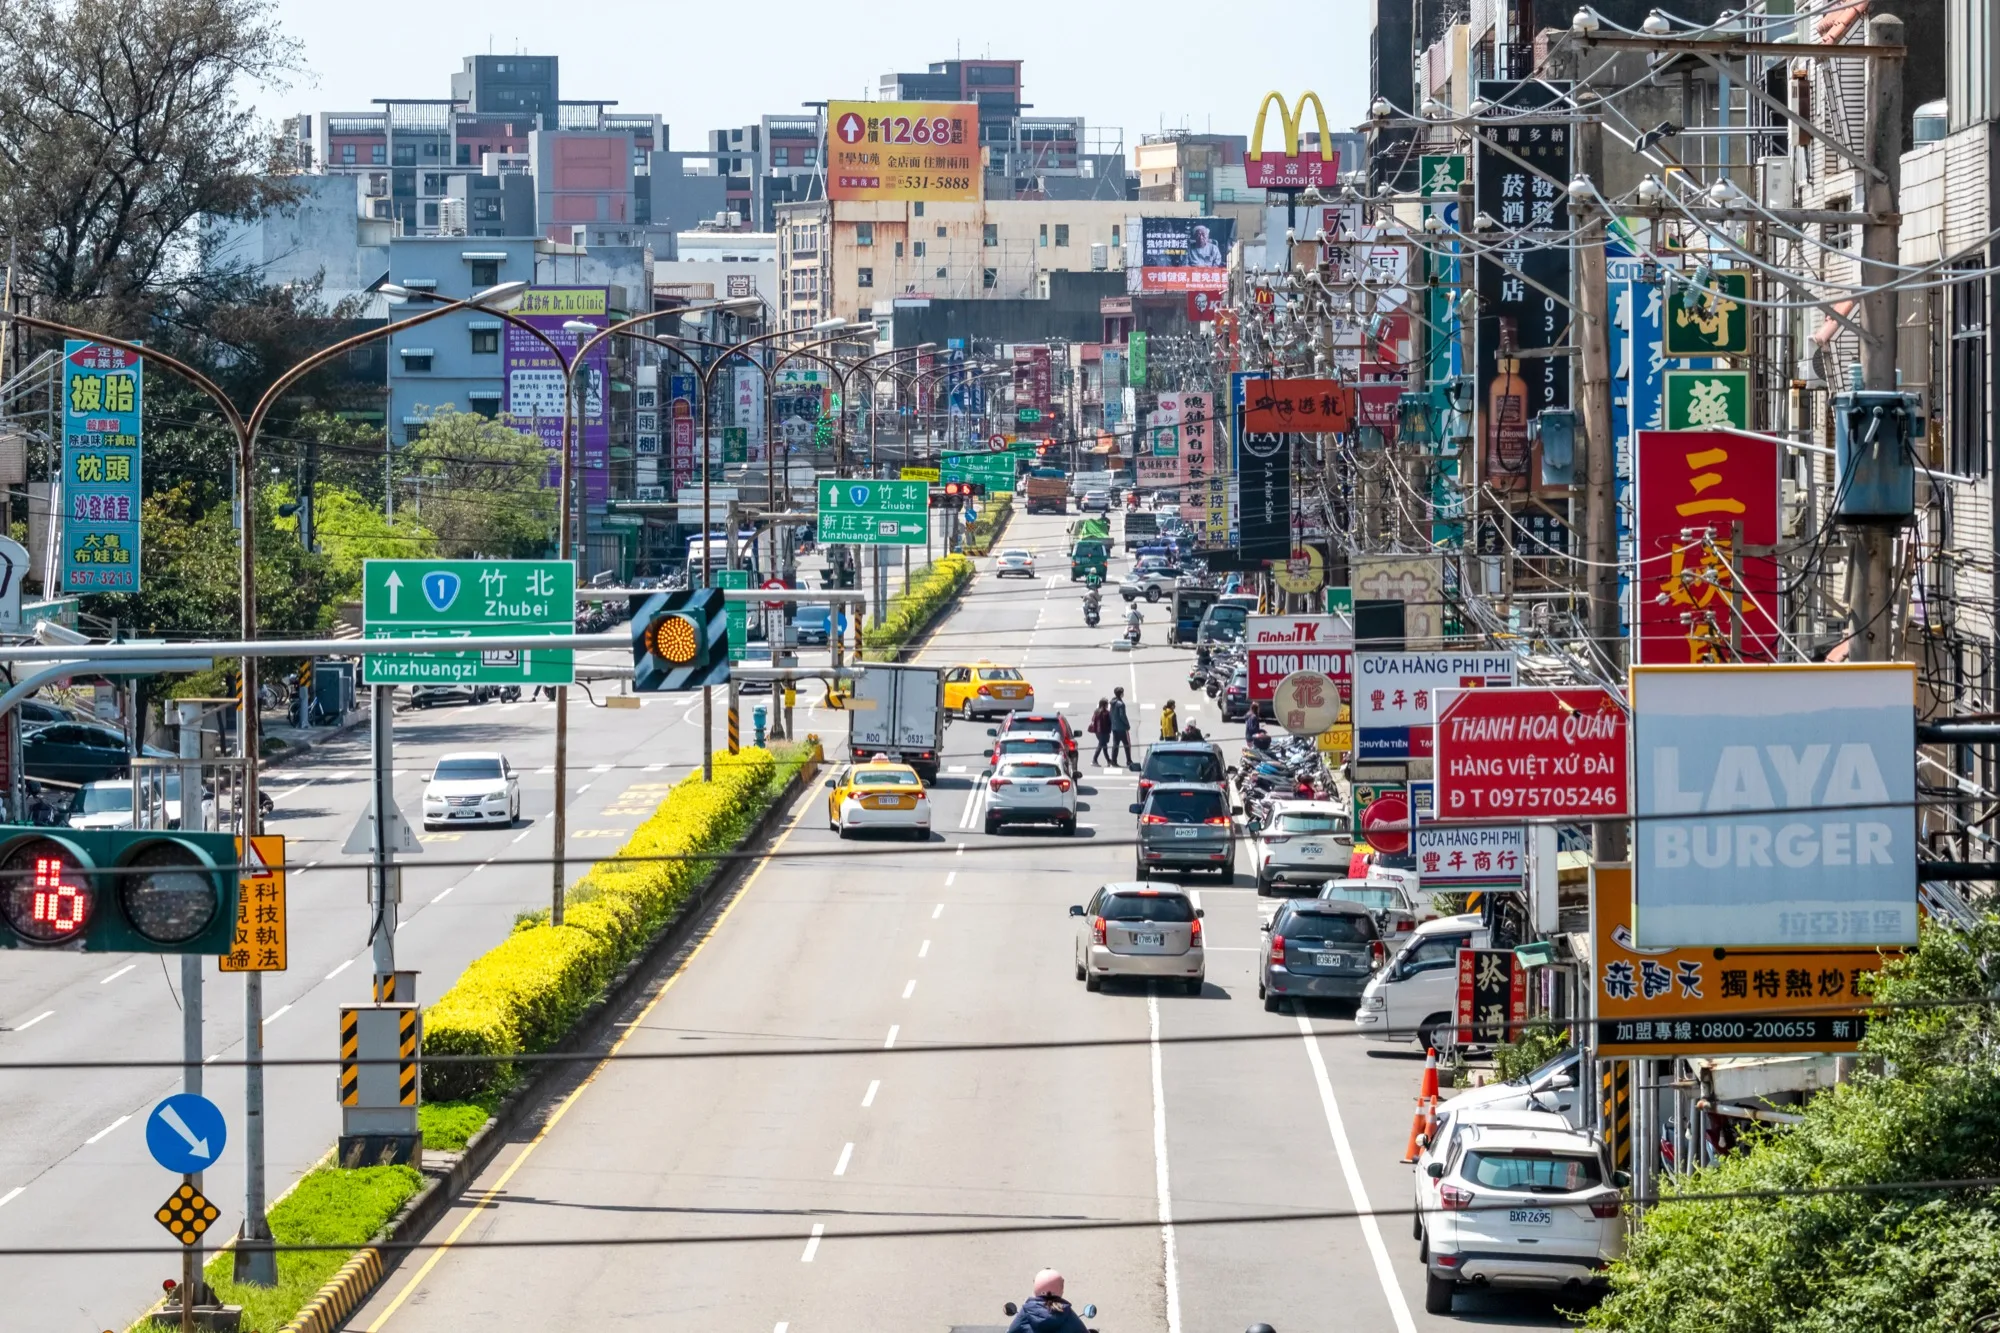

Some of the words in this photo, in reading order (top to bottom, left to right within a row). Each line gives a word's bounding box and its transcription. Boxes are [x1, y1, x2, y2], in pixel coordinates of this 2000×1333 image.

[880, 117, 950, 145] 1268
[1487, 128, 1564, 142] 格蘭多納
[887, 155, 921, 169] 金店面
[1262, 163, 1322, 175] 麥當勞
[904, 176, 969, 189] 531-5888
[1260, 176, 1323, 185] McDonald's
[577, 294, 603, 310] Clinic
[71, 374, 135, 412] 被胎
[77, 455, 130, 482] 枕頭
[878, 484, 917, 500] 竹北
[74, 495, 130, 522] 沙發椅套
[881, 501, 914, 510] Zhubei
[822, 515, 877, 530] 新庄子
[822, 531, 877, 542] Xinzhuangzi
[74, 549, 129, 564] 布娃娃
[70, 571, 133, 585] 557-3213
[479, 569, 554, 597] 竹北
[437, 579, 445, 599] 1
[485, 601, 549, 617] Zhubei
[372, 660, 477, 681] Xinzhuangzi
[1257, 655, 1299, 675] TOKO
[1302, 655, 1341, 674] INDO
[1363, 656, 1399, 674] CỬA
[1403, 656, 1448, 674] HÀNG
[1452, 659, 1479, 673] PHI
[1484, 658, 1510, 673] PHI
[1370, 690, 1429, 711] 豐年商
[1451, 716, 1514, 742] THANH
[1519, 714, 1558, 740] HOA
[1562, 709, 1617, 744] QUÁN
[1450, 754, 1503, 777] HÀNG
[1508, 754, 1549, 780] VIỆT
[1553, 752, 1580, 774] XỨ
[1583, 752, 1615, 774] ĐÀI
[1653, 743, 1891, 815] LAYA
[1471, 788, 1484, 807] T
[1489, 786, 1617, 807] 0975705246
[1480, 831, 1499, 845] PHI
[1502, 830, 1521, 845] PHI
[1654, 822, 1894, 868] BURGER
[1422, 850, 1518, 873] 豐年商行
[255, 882, 279, 966] 科技執法
[1779, 910, 1901, 936] 拉亞漢堡
[1476, 954, 1509, 1038] 菸酒
[1616, 1020, 1816, 1041] 加盟專線:0800-200655
